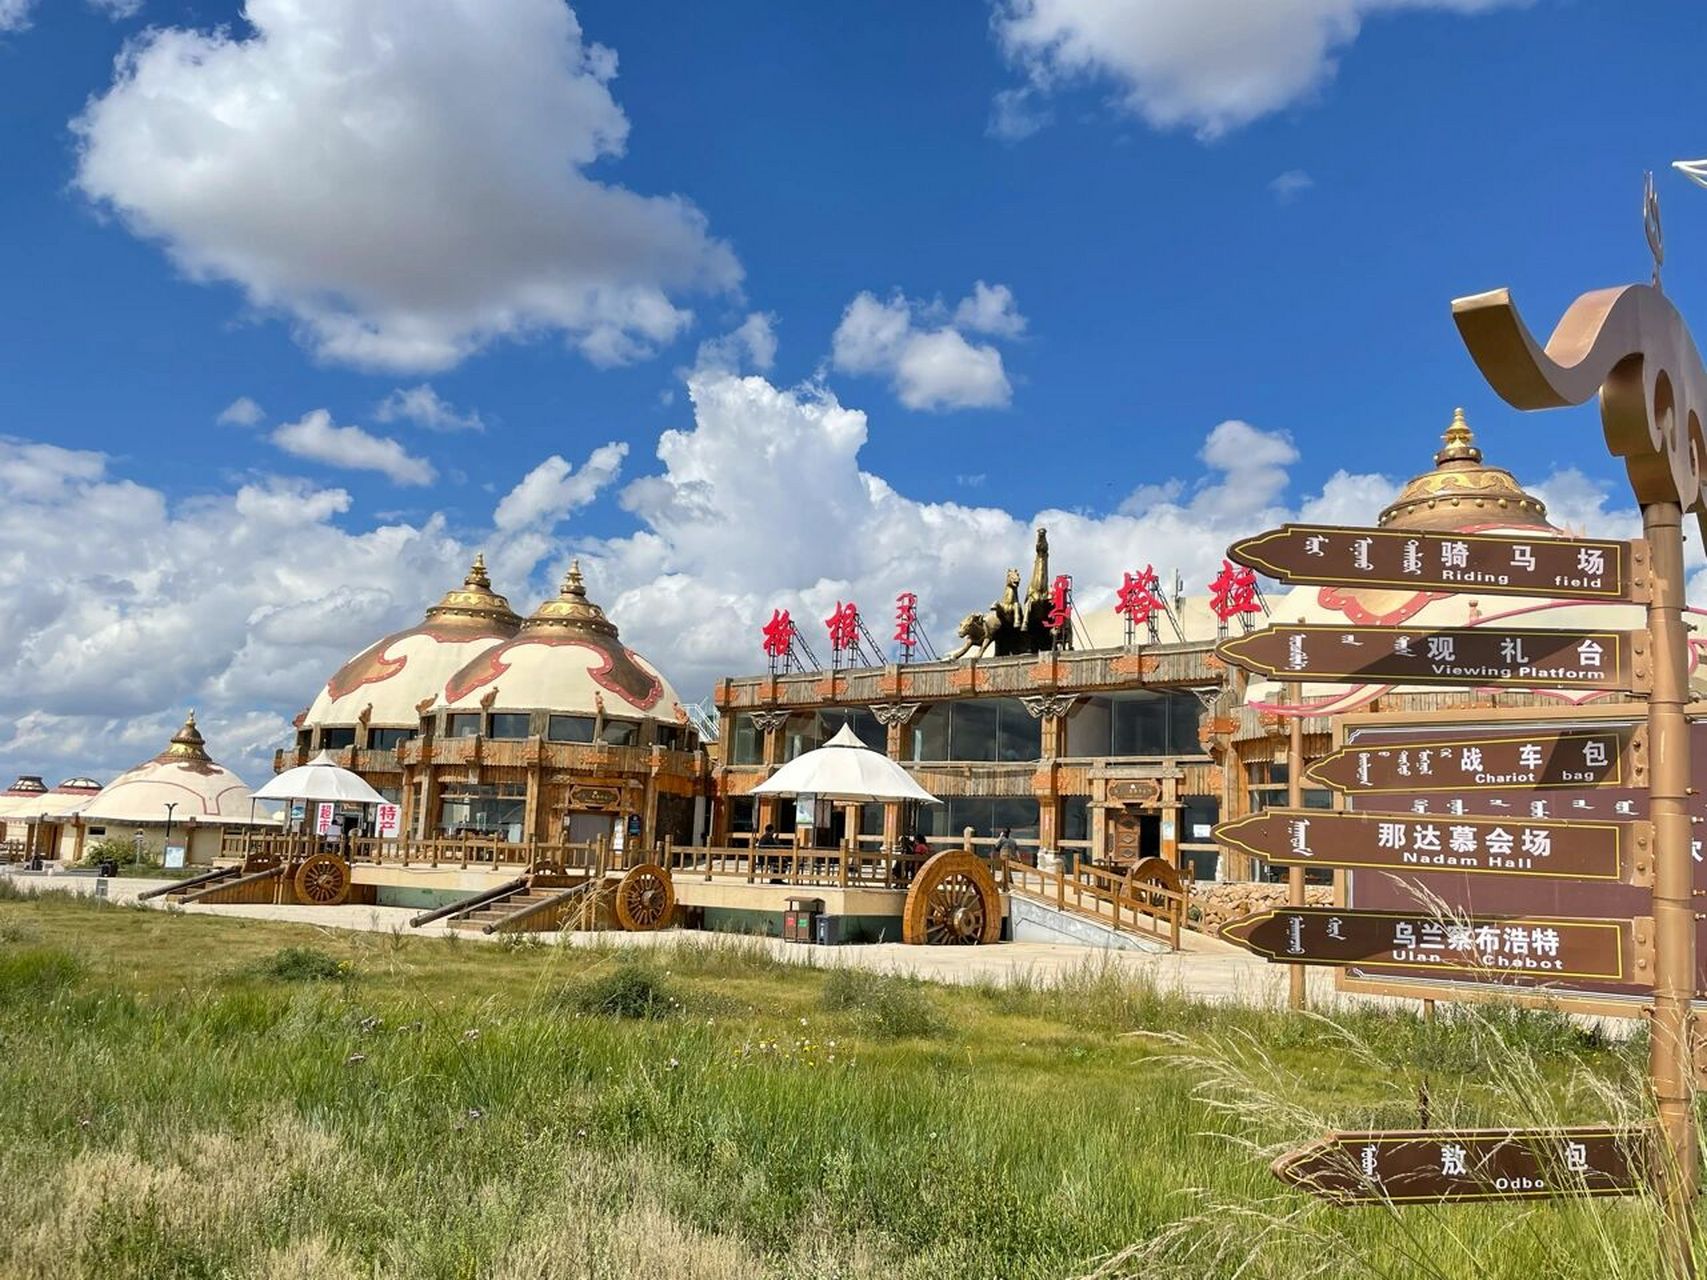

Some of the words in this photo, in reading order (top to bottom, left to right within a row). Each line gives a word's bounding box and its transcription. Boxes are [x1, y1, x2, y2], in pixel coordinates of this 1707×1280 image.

[1441, 540, 1605, 576] 骑马场
[1442, 569, 1509, 586] Riding
[1554, 575, 1602, 588] field
[1427, 636, 1604, 667] 观礼台
[1432, 664, 1511, 679] Viewing
[1518, 666, 1605, 680] Platform
[1460, 740, 1608, 773] 战车包
[1475, 772, 1536, 784] Chariot
[1562, 769, 1595, 783] bag
[1378, 822, 1552, 857] 那达慕会场
[1403, 852, 1478, 867] Nadam
[1488, 856, 1532, 870] Hall
[1392, 950, 1441, 963] Ulan
[1440, 1141, 1588, 1175] 敖包
[1495, 1177, 1545, 1190] Odbo
